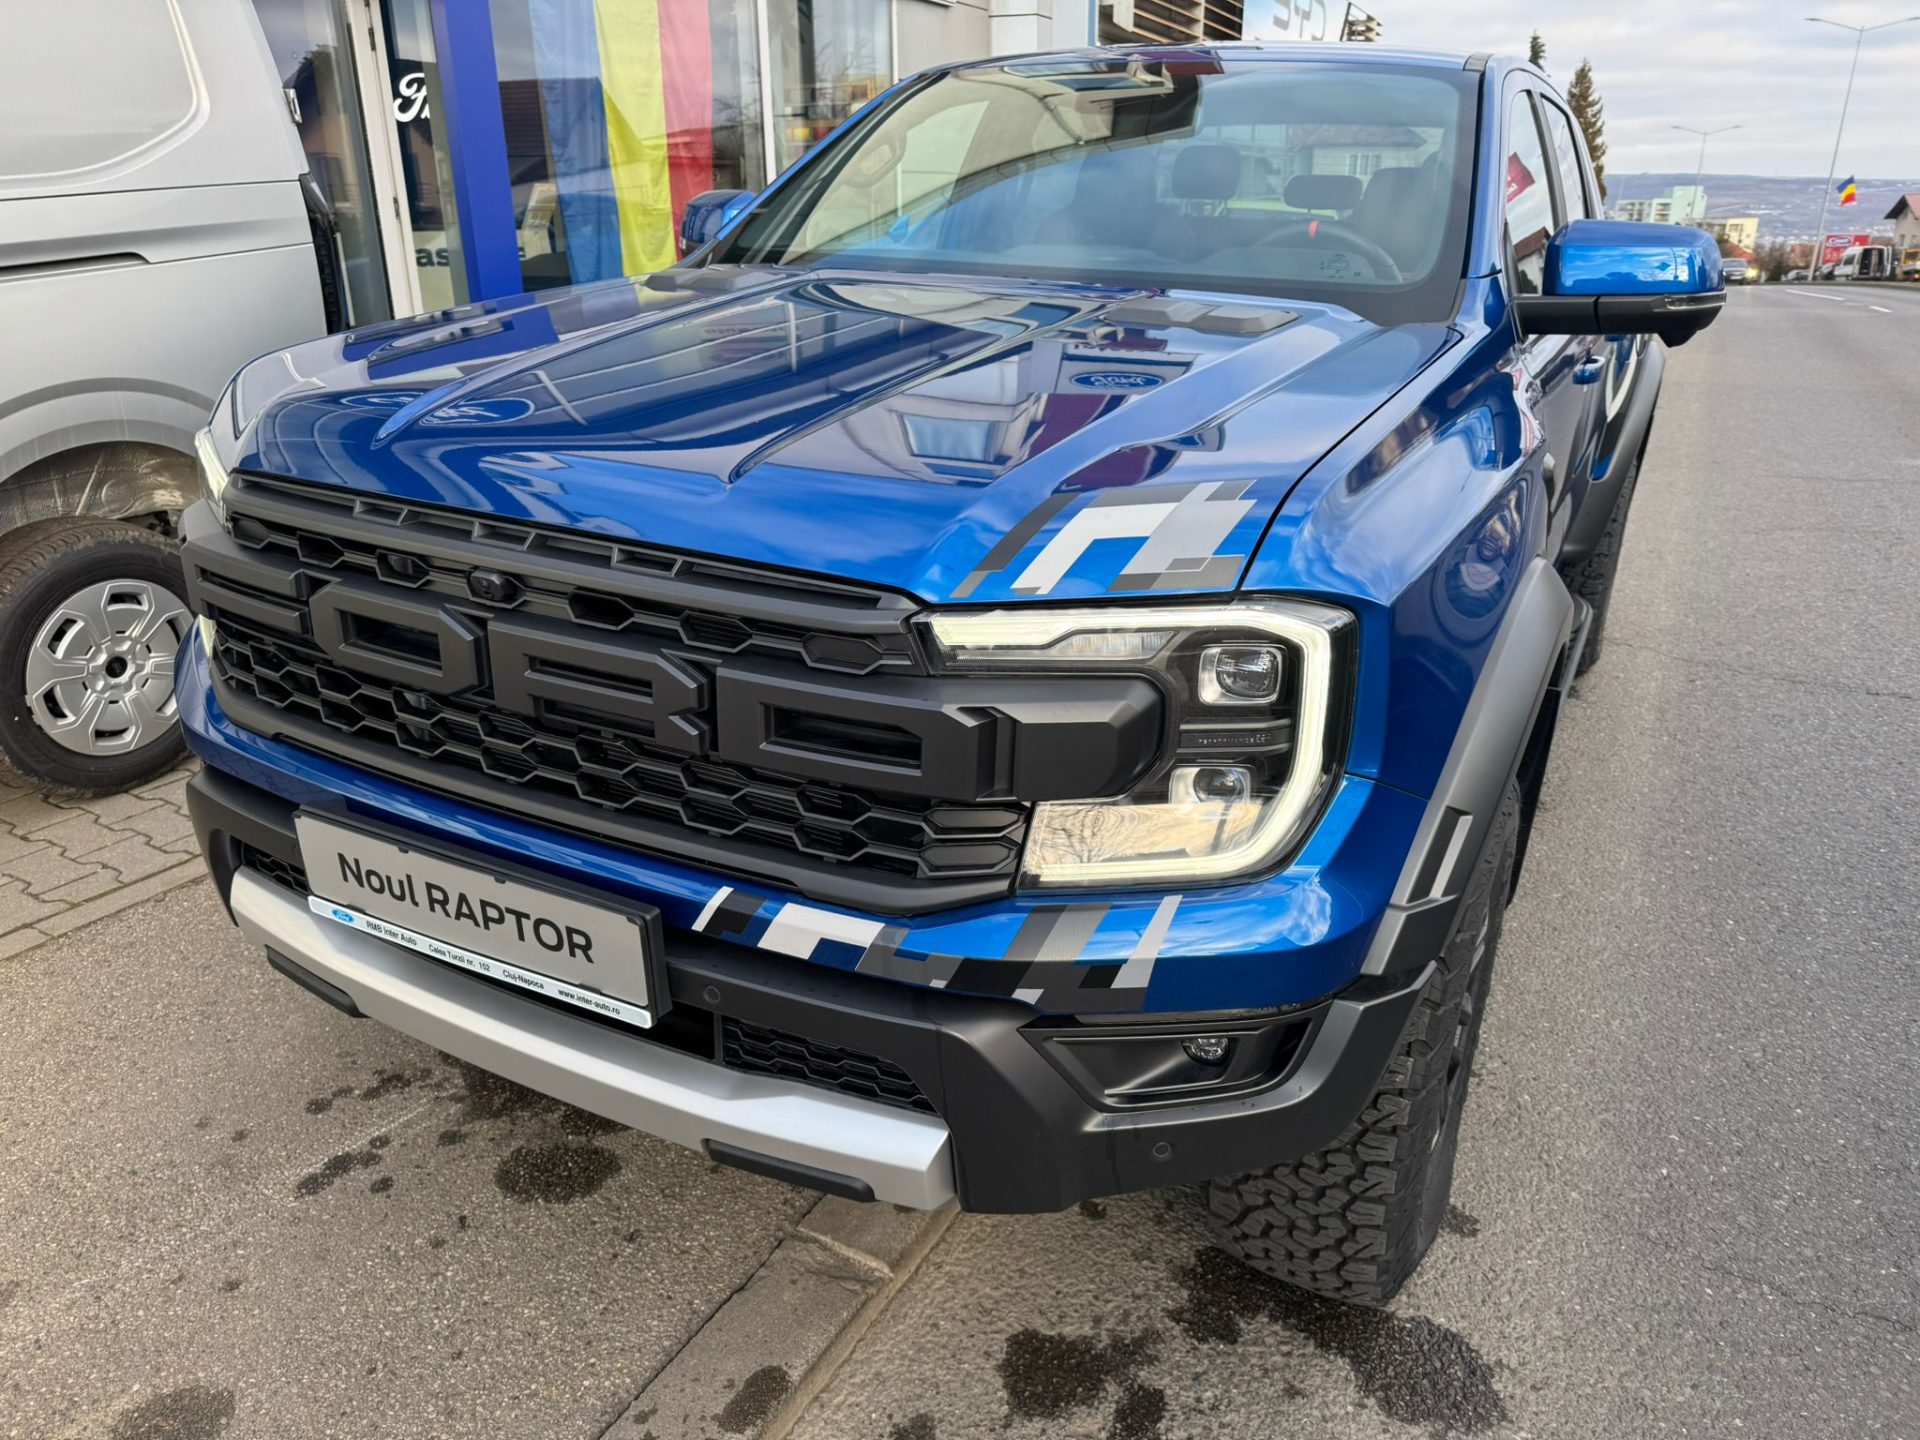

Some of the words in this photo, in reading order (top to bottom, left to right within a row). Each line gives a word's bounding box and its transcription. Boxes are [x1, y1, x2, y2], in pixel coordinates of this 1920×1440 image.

[337, 852, 419, 907] Noul
[425, 881, 594, 964] RAPTOR
[366, 920, 383, 933] RMB
[400, 933, 418, 946] Auto
[428, 944, 447, 957] Calea
[478, 961, 491, 972] 152
[502, 969, 545, 990] Cluj-Napoca
[558, 989, 621, 1015] www.inter-auto.ro
